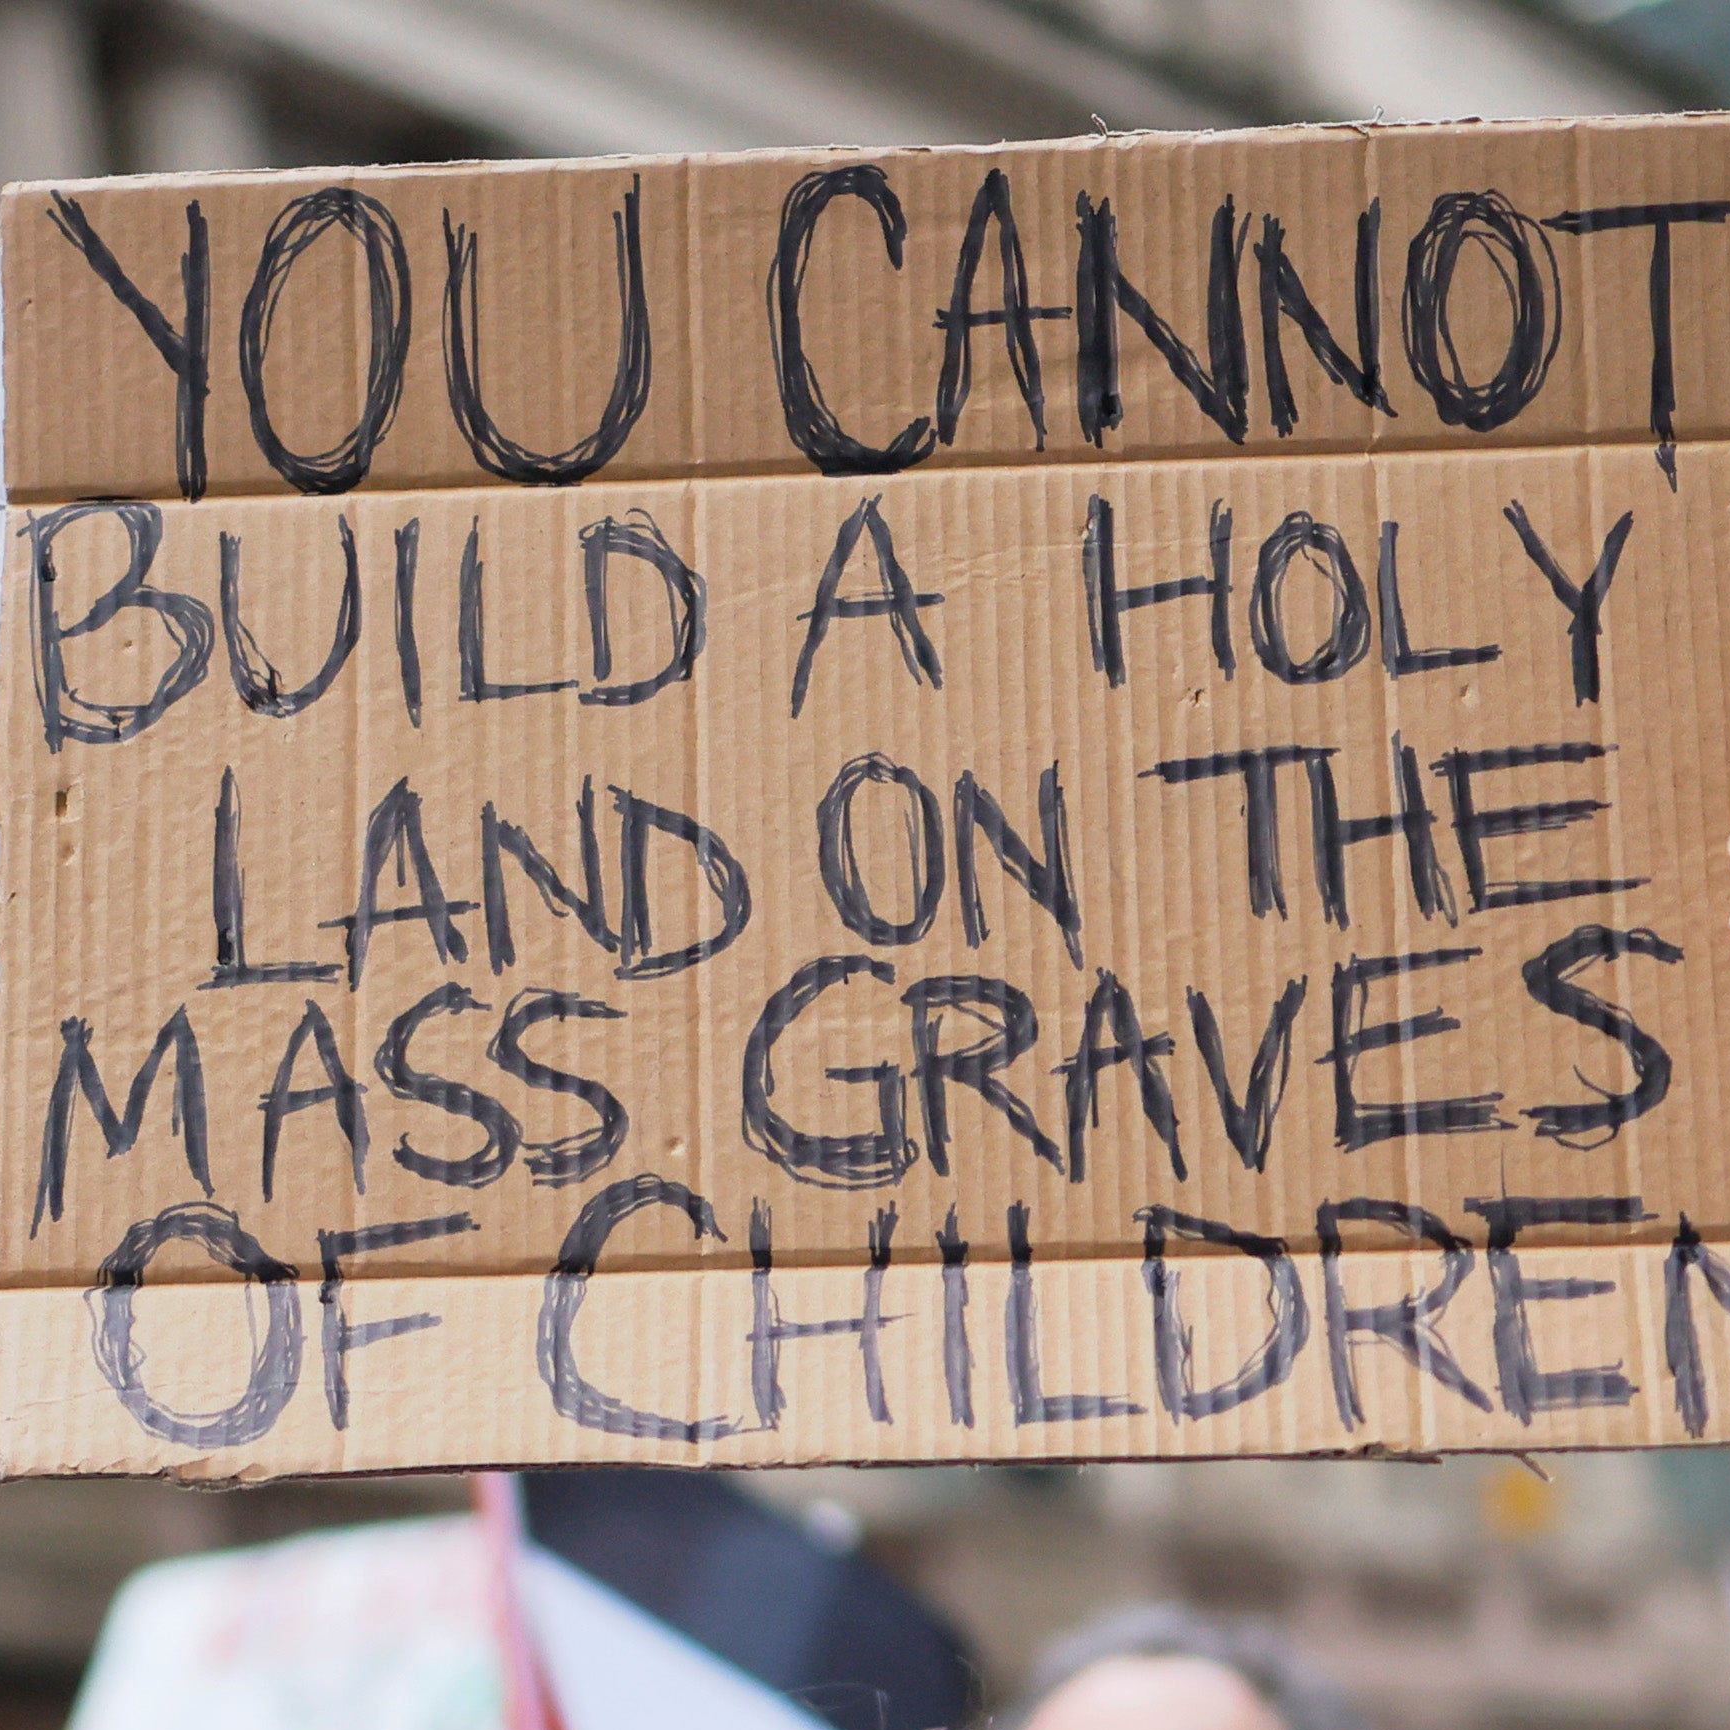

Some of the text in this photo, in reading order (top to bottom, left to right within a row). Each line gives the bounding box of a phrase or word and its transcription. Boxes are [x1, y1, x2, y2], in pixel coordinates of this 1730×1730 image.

[47, 174, 651, 497] YOU
[24, 493, 1634, 753] BUILD A HOLY
[195, 730, 1650, 992] LAND ON THE
[31, 923, 1684, 1238] MASS GRAVES
[90, 1199, 480, 1448] OF
